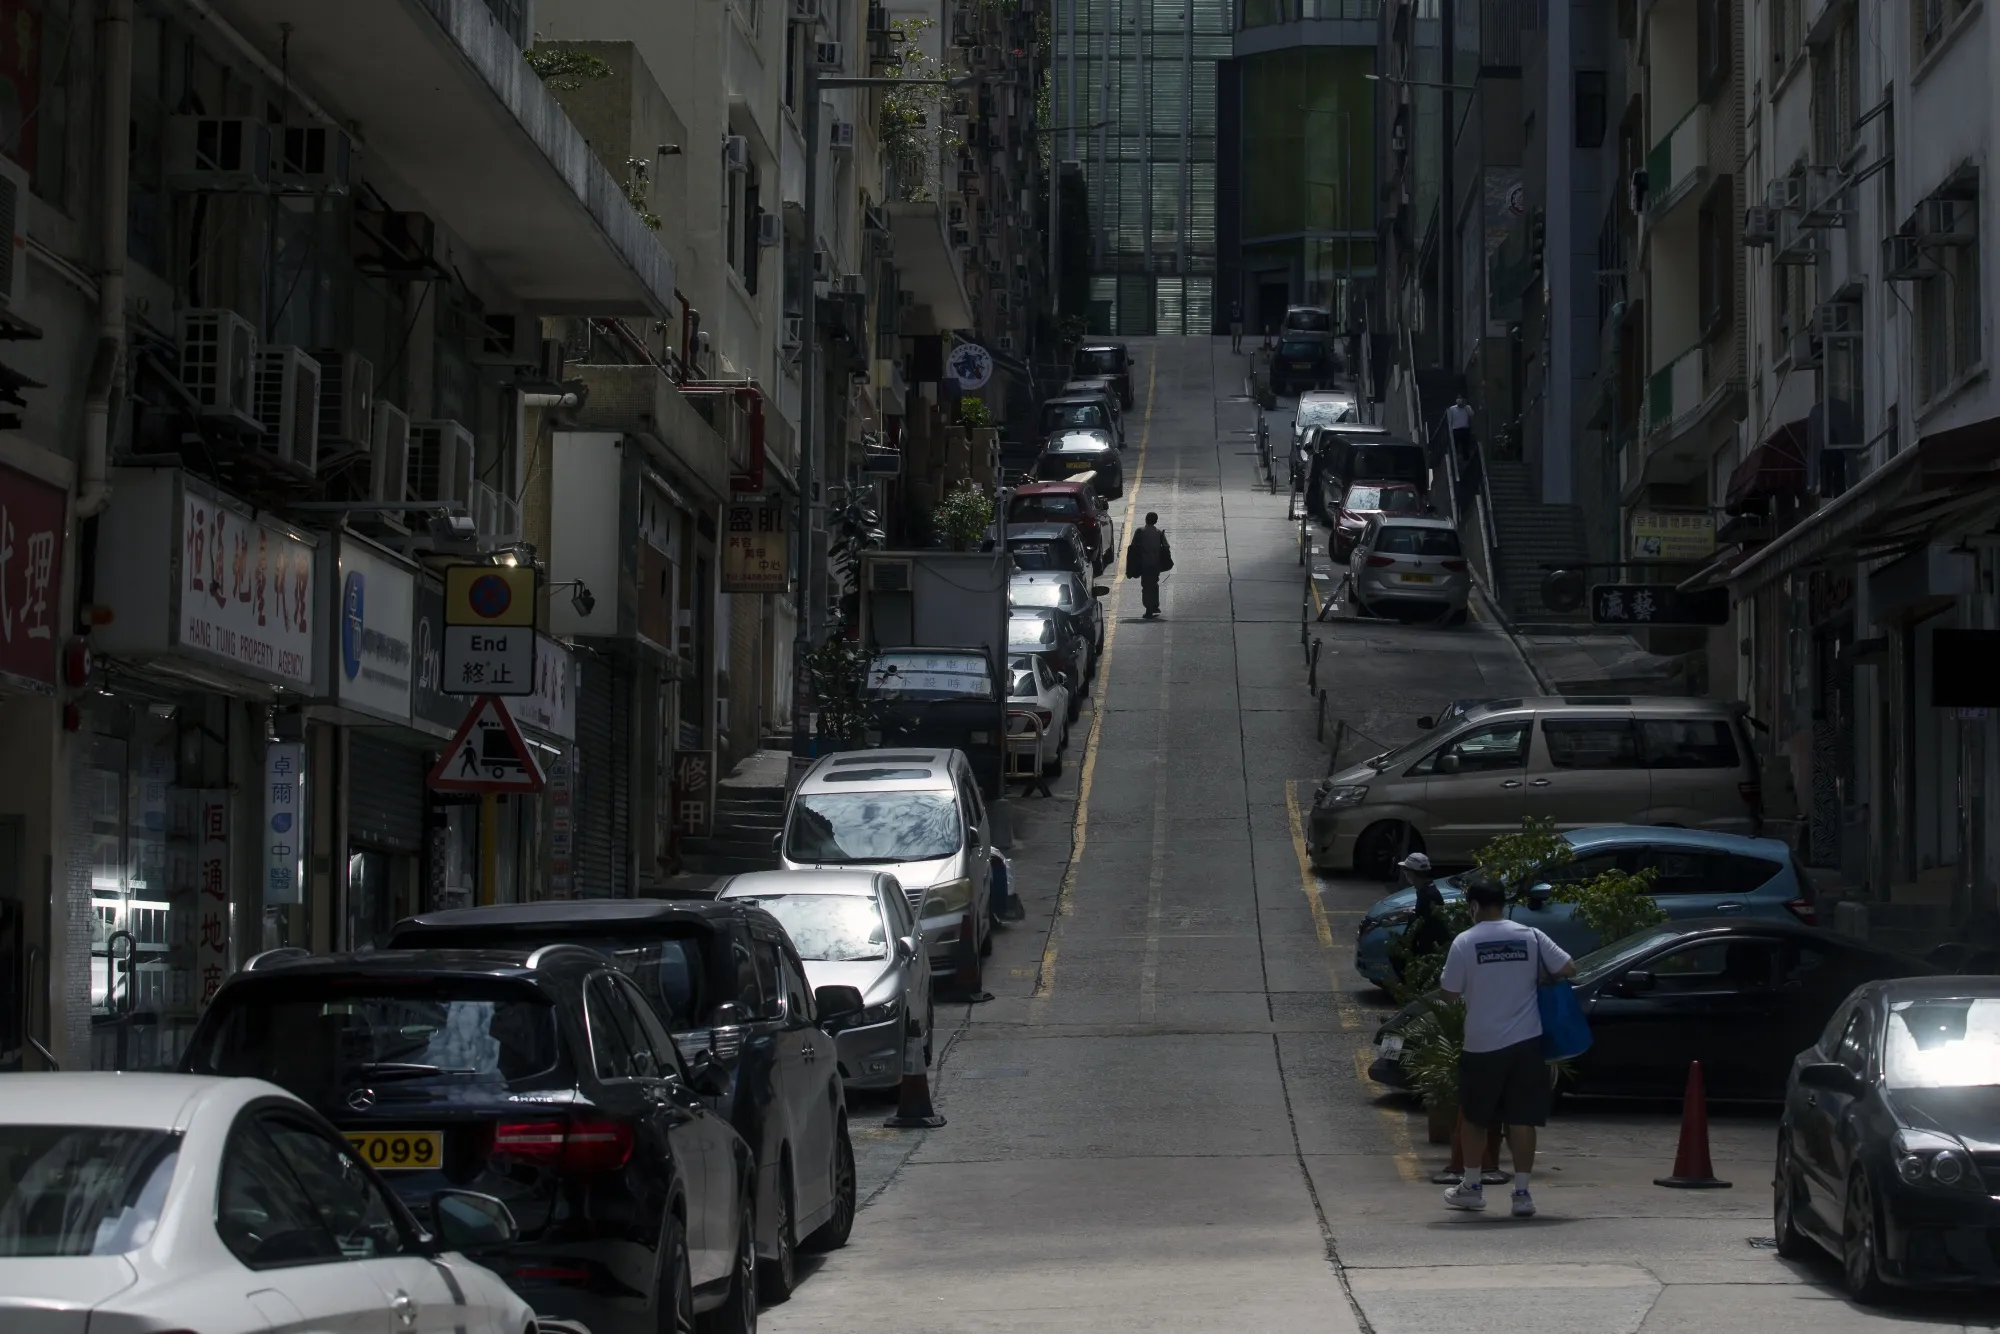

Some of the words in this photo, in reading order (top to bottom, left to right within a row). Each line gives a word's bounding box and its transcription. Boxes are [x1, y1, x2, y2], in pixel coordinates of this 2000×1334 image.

[189, 617, 211, 648] HANG
[215, 625, 237, 657] TUNG
[240, 635, 274, 669] PROPERTY
[277, 648, 304, 677] AGENCY
[471, 635, 507, 651] End
[462, 661, 514, 685] 終止
[271, 756, 292, 804] 卓爾
[679, 756, 707, 834] 修甲
[1479, 950, 1526, 963] patagonia
[508, 1095, 553, 1103] 4MATIC
